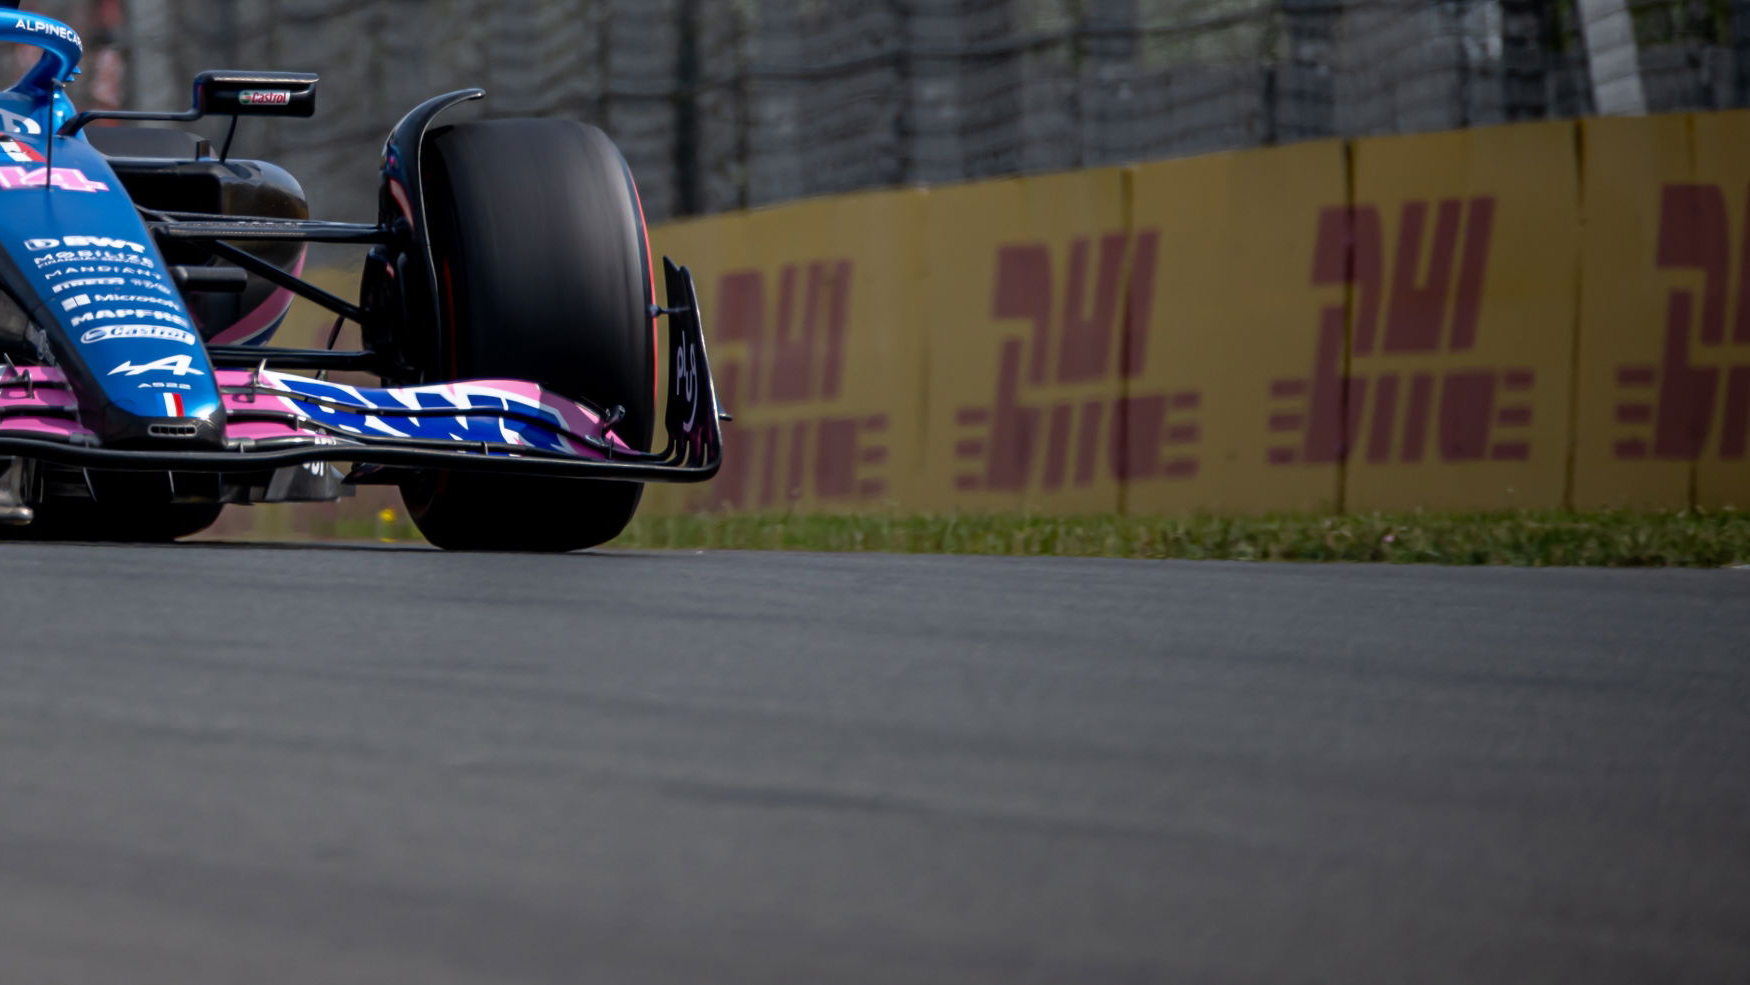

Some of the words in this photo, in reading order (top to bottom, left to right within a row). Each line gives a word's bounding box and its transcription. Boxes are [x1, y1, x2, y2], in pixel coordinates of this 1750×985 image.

[251, 91, 287, 104] Castrol
[62, 235, 146, 253] BWT
[71, 309, 189, 327] MAPFRE
[1300, 196, 1502, 466] DHL
